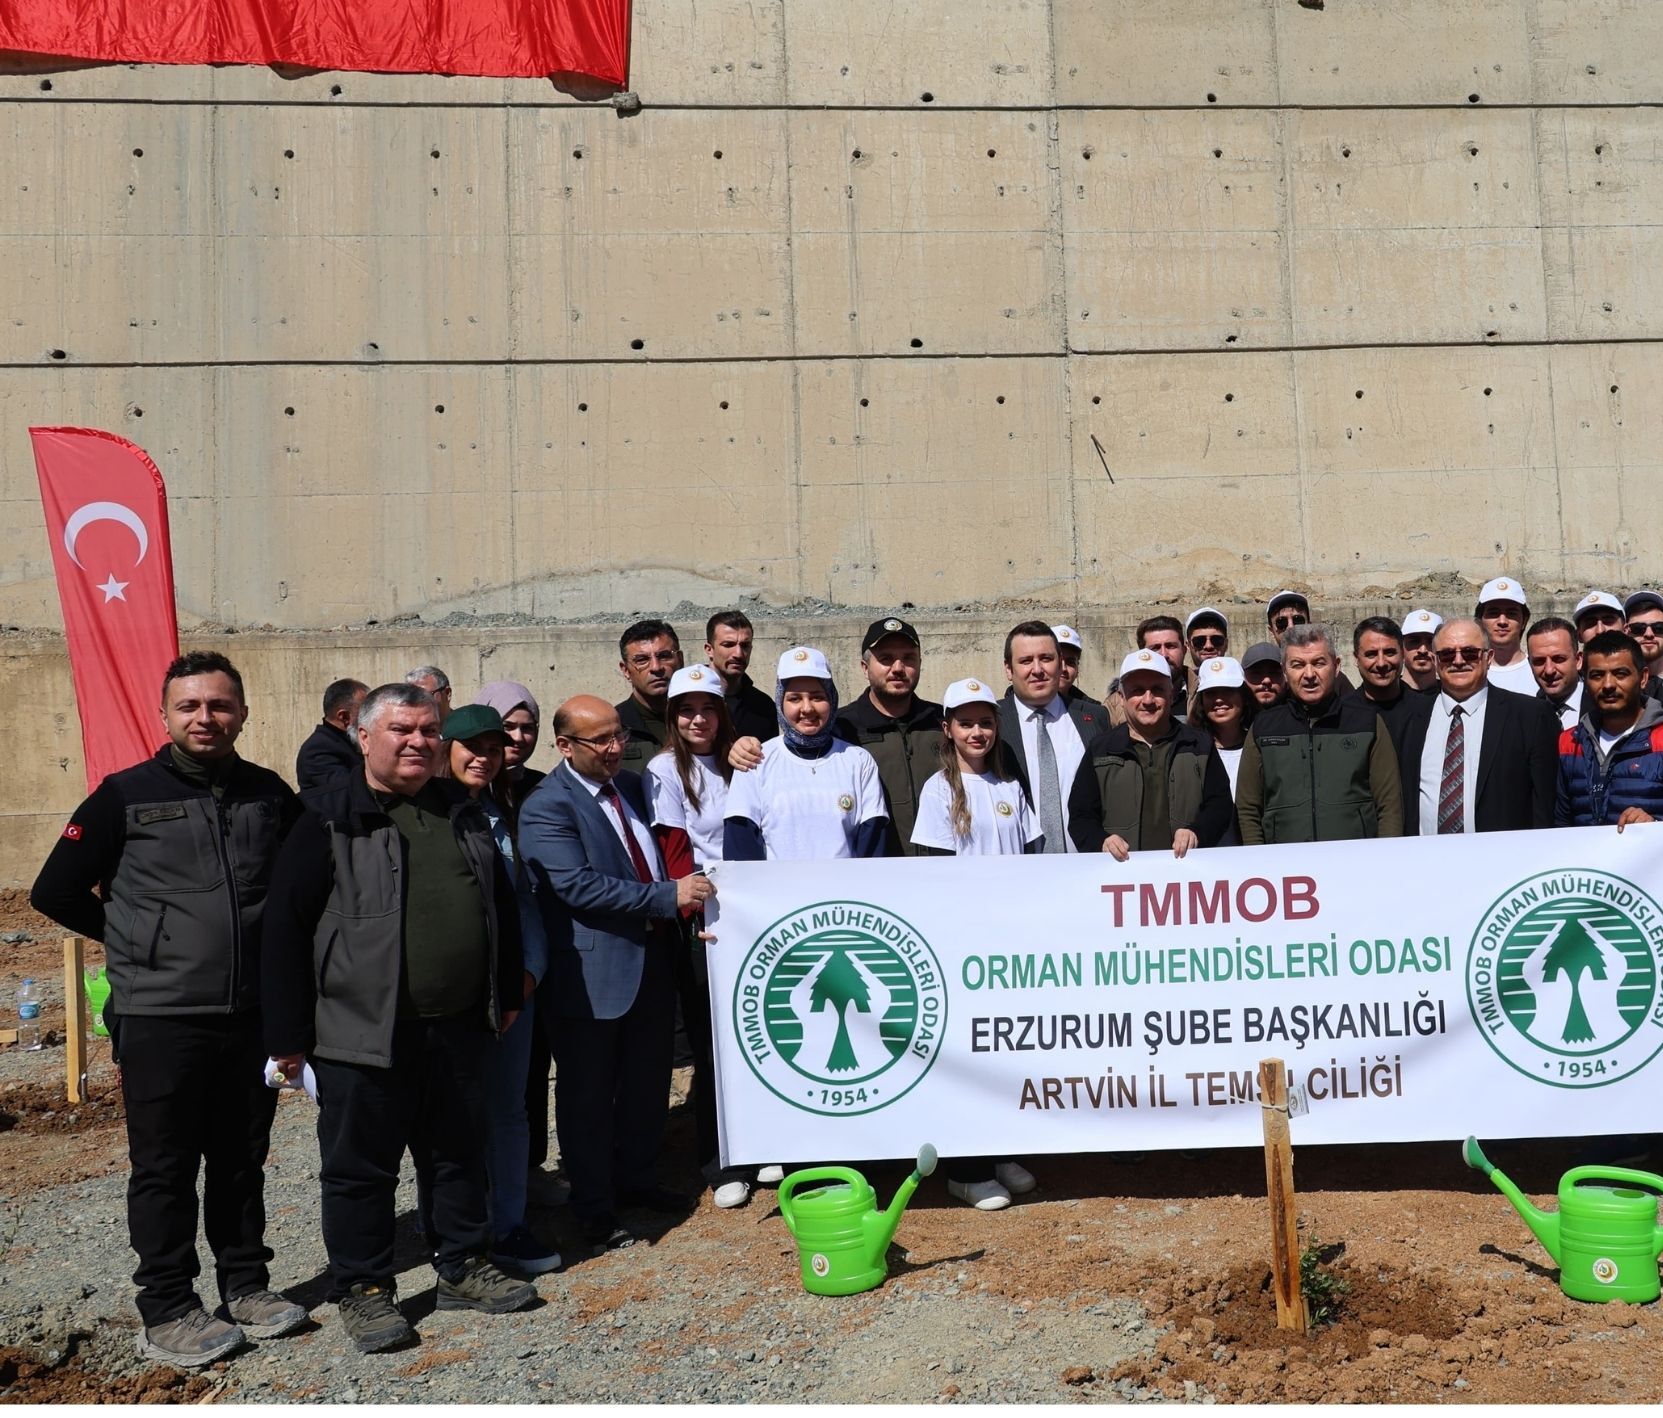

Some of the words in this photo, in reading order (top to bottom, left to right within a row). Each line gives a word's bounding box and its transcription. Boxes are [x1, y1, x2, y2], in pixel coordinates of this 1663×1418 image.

[1101, 876, 1320, 927] TMMOB
[1481, 887, 1540, 952] ORMAN
[749, 918, 809, 980] ORMAN
[812, 906, 940, 992] MÜHENDİSLERİ
[962, 952, 1082, 990] ORMAN
[1094, 933, 1338, 986] MÜHENDİSLERİ
[1349, 936, 1451, 976] ODASI
[742, 984, 771, 1065] TMMOB
[971, 1012, 1132, 1053] ERZURUM
[1143, 1008, 1232, 1055] ŞUBE
[1244, 990, 1446, 1049] BAŞKANLIĞI
[1475, 956, 1505, 1036] TMMOB
[911, 996, 939, 1060] ODASI
[820, 1088, 868, 1106] 1954
[1019, 1066, 1138, 1109] ARTVİN
[1149, 1065, 1177, 1107] İL
[1558, 1059, 1607, 1078] 1954
